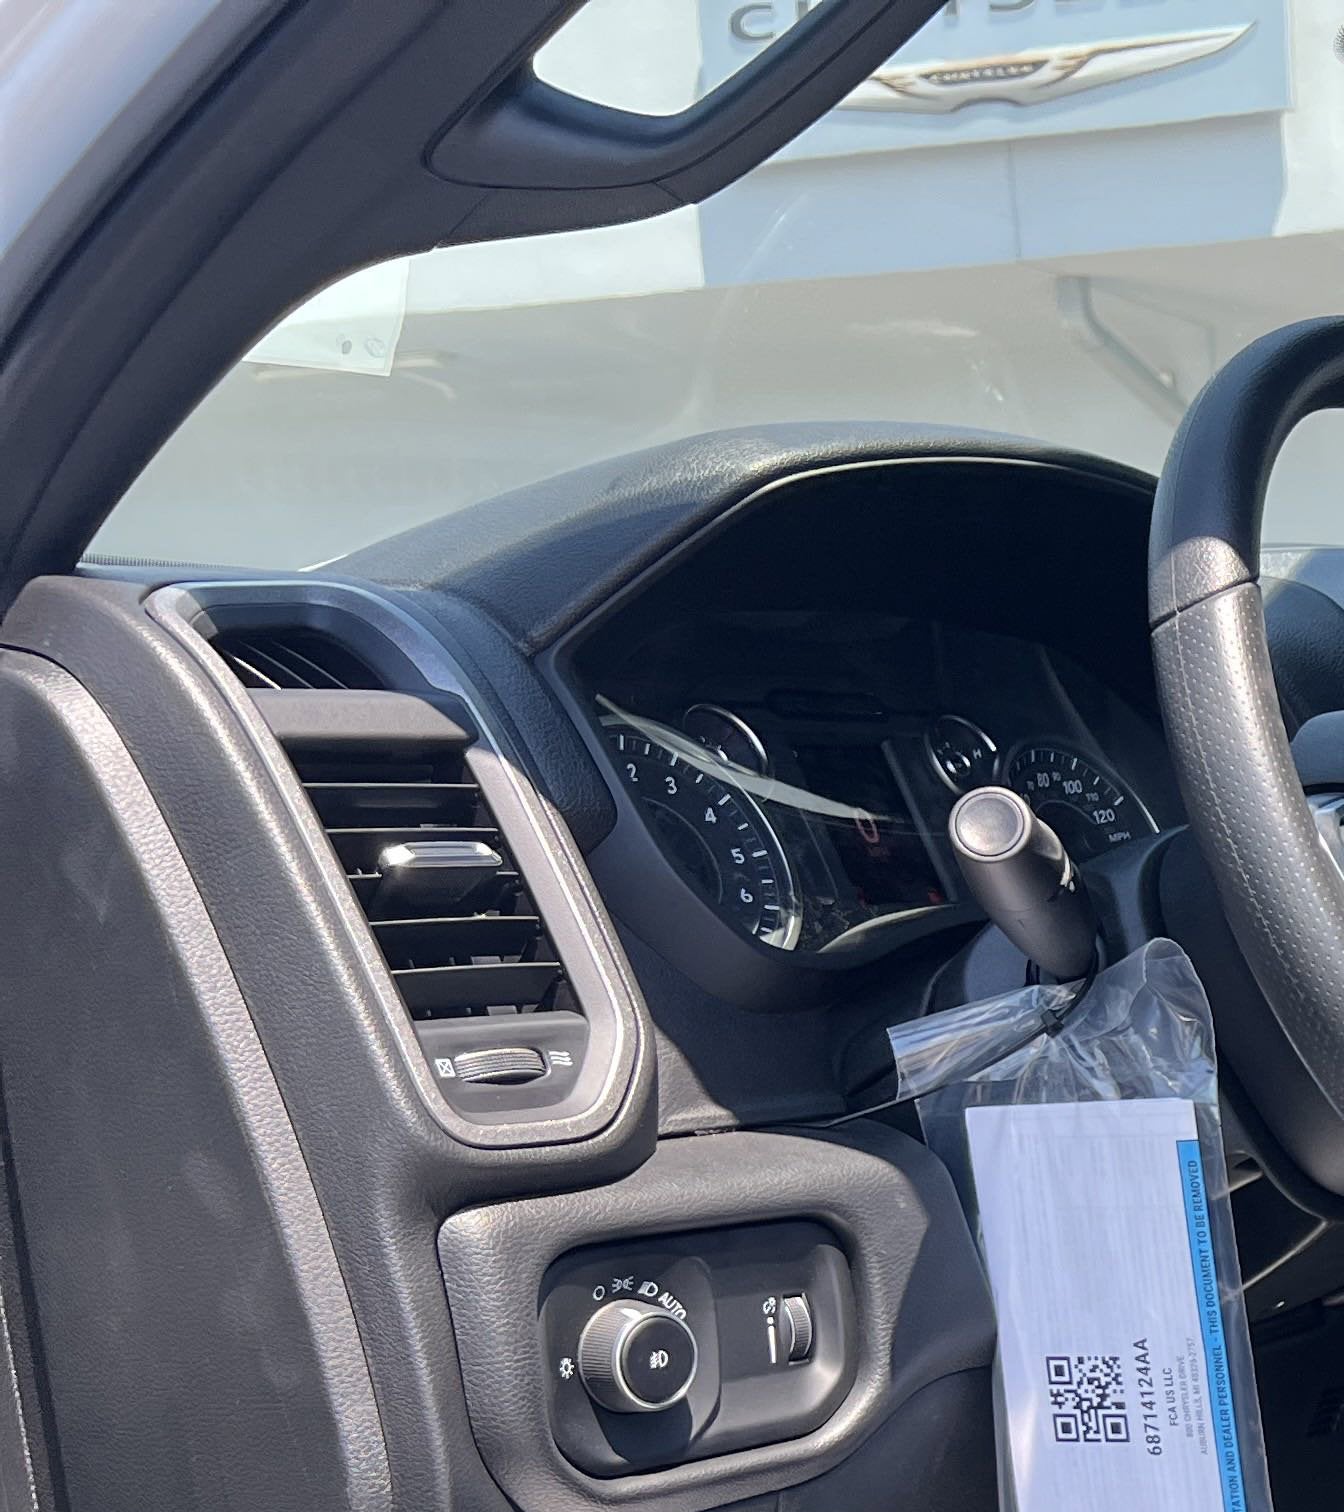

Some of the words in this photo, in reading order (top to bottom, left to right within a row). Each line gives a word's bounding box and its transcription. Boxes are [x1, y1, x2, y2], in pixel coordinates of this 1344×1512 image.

[626, 763, 639, 782] 2
[1036, 772, 1050, 788] 80
[665, 776, 678, 795] 3
[1062, 779, 1083, 795] 100
[704, 807, 718, 825] 4
[1092, 808, 1116, 825] 120
[730, 848, 745, 865] 5
[740, 888, 754, 903] 6
[1188, 1160, 1203, 1211] REMOVED
[1195, 1212, 1206, 1229] BE
[1197, 1230, 1208, 1246] TO
[1199, 1248, 1216, 1308] DOCUMENT
[658, 1293, 687, 1320] AUTO
[1208, 1310, 1220, 1335] THIS
[1162, 1367, 1174, 1387] LLC
[1212, 1345, 1229, 1407] PERSONNEL
[1133, 1338, 1162, 1456] 68714124AA
[1165, 1389, 1176, 1404] US
[1168, 1406, 1179, 1427] FCA
[1219, 1409, 1234, 1451] DEALER
[1225, 1451, 1238, 1473] AND
